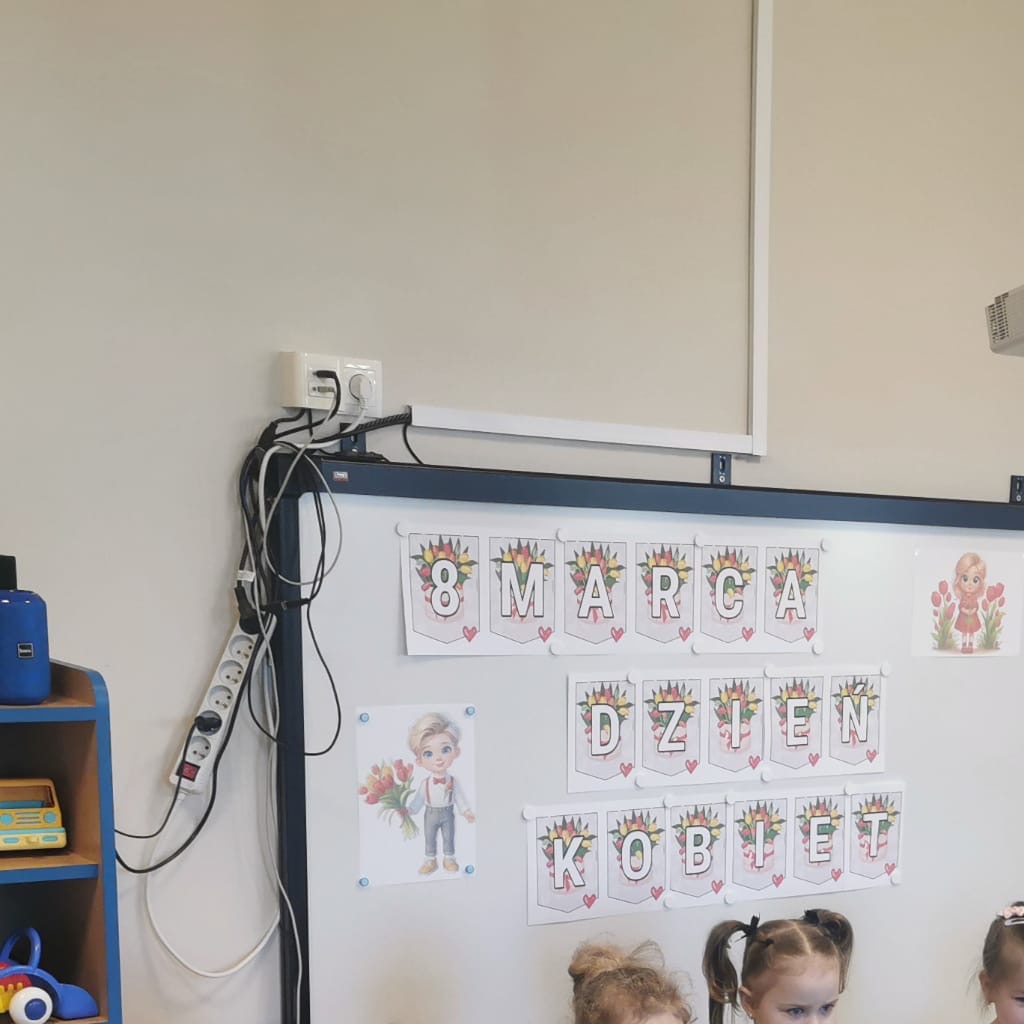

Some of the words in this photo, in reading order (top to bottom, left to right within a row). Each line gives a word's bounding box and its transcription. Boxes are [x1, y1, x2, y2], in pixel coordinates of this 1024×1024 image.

[430, 558, 461, 617] 8
[499, 560, 807, 620] MARCA
[590, 682, 868, 757] DZIEŃ
[552, 811, 888, 890] KOBIET
